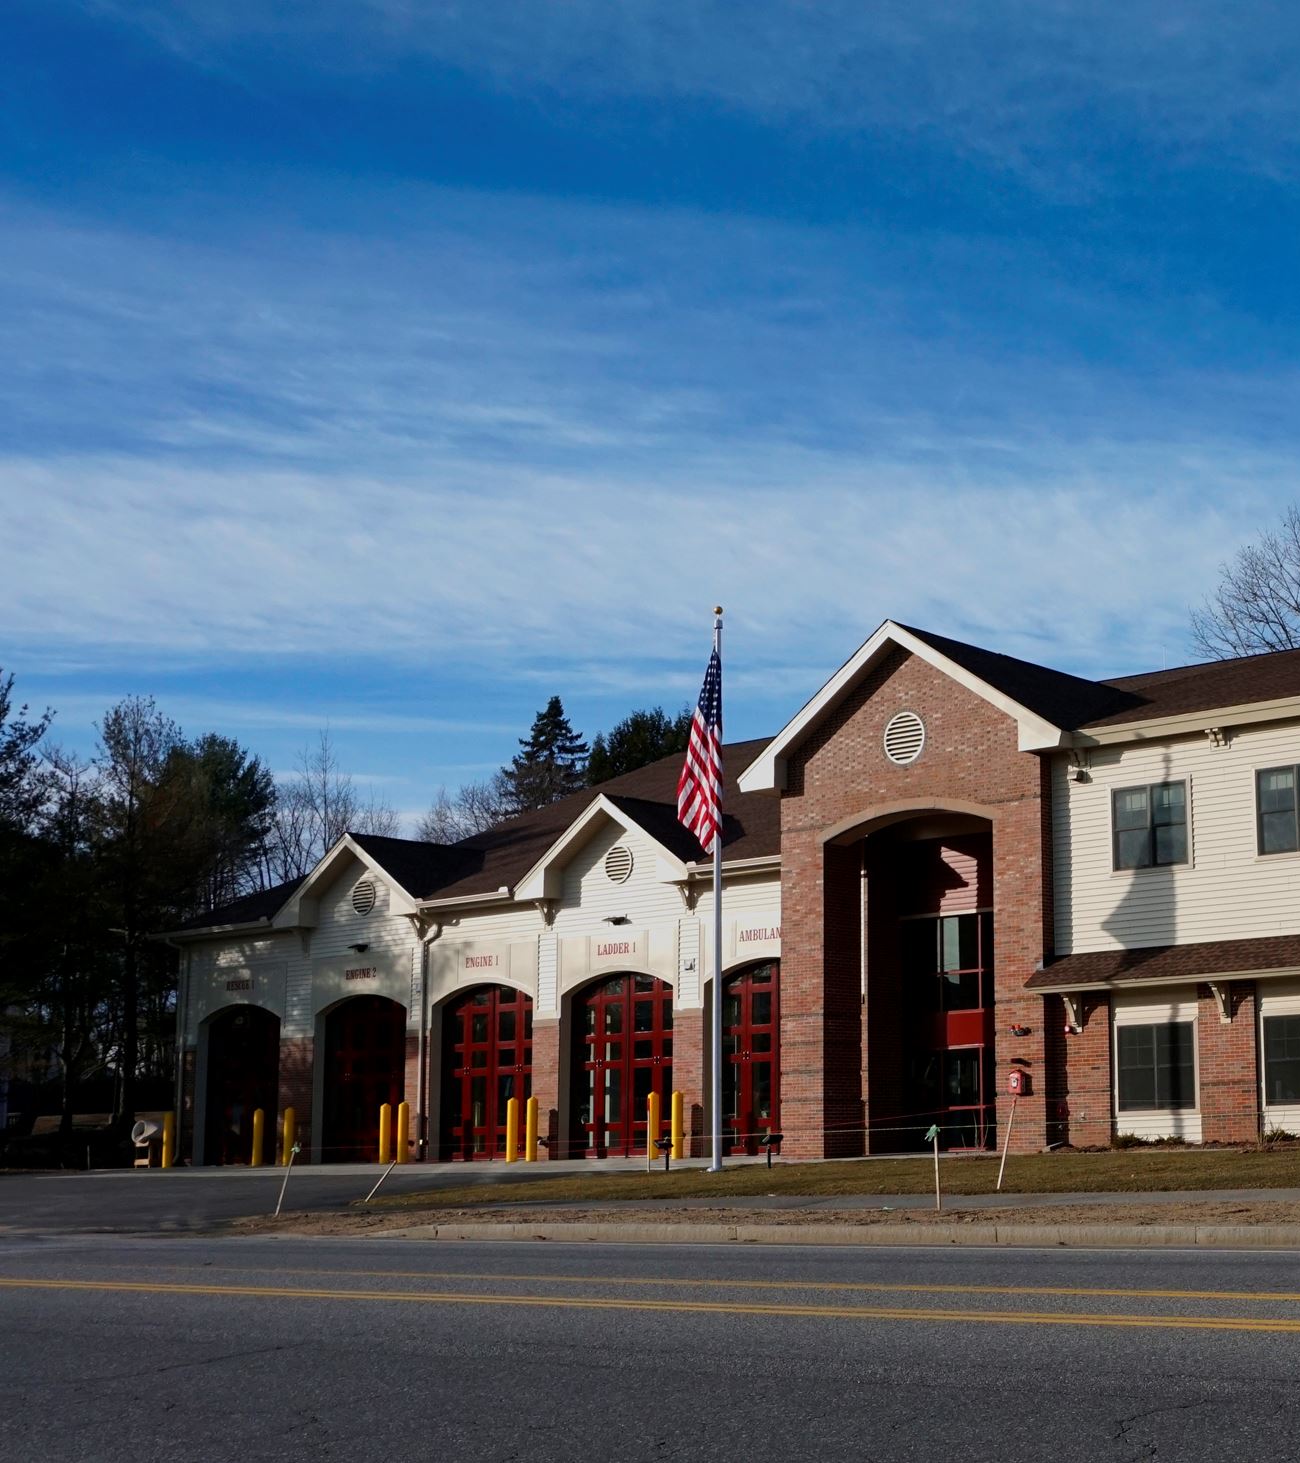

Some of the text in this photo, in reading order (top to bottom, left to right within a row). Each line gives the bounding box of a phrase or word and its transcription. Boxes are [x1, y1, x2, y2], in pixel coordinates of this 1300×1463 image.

[597, 942, 636, 956] LADDER 1
[465, 955, 499, 968] ENGINE 1
[345, 967, 377, 980] ENGINE 2
